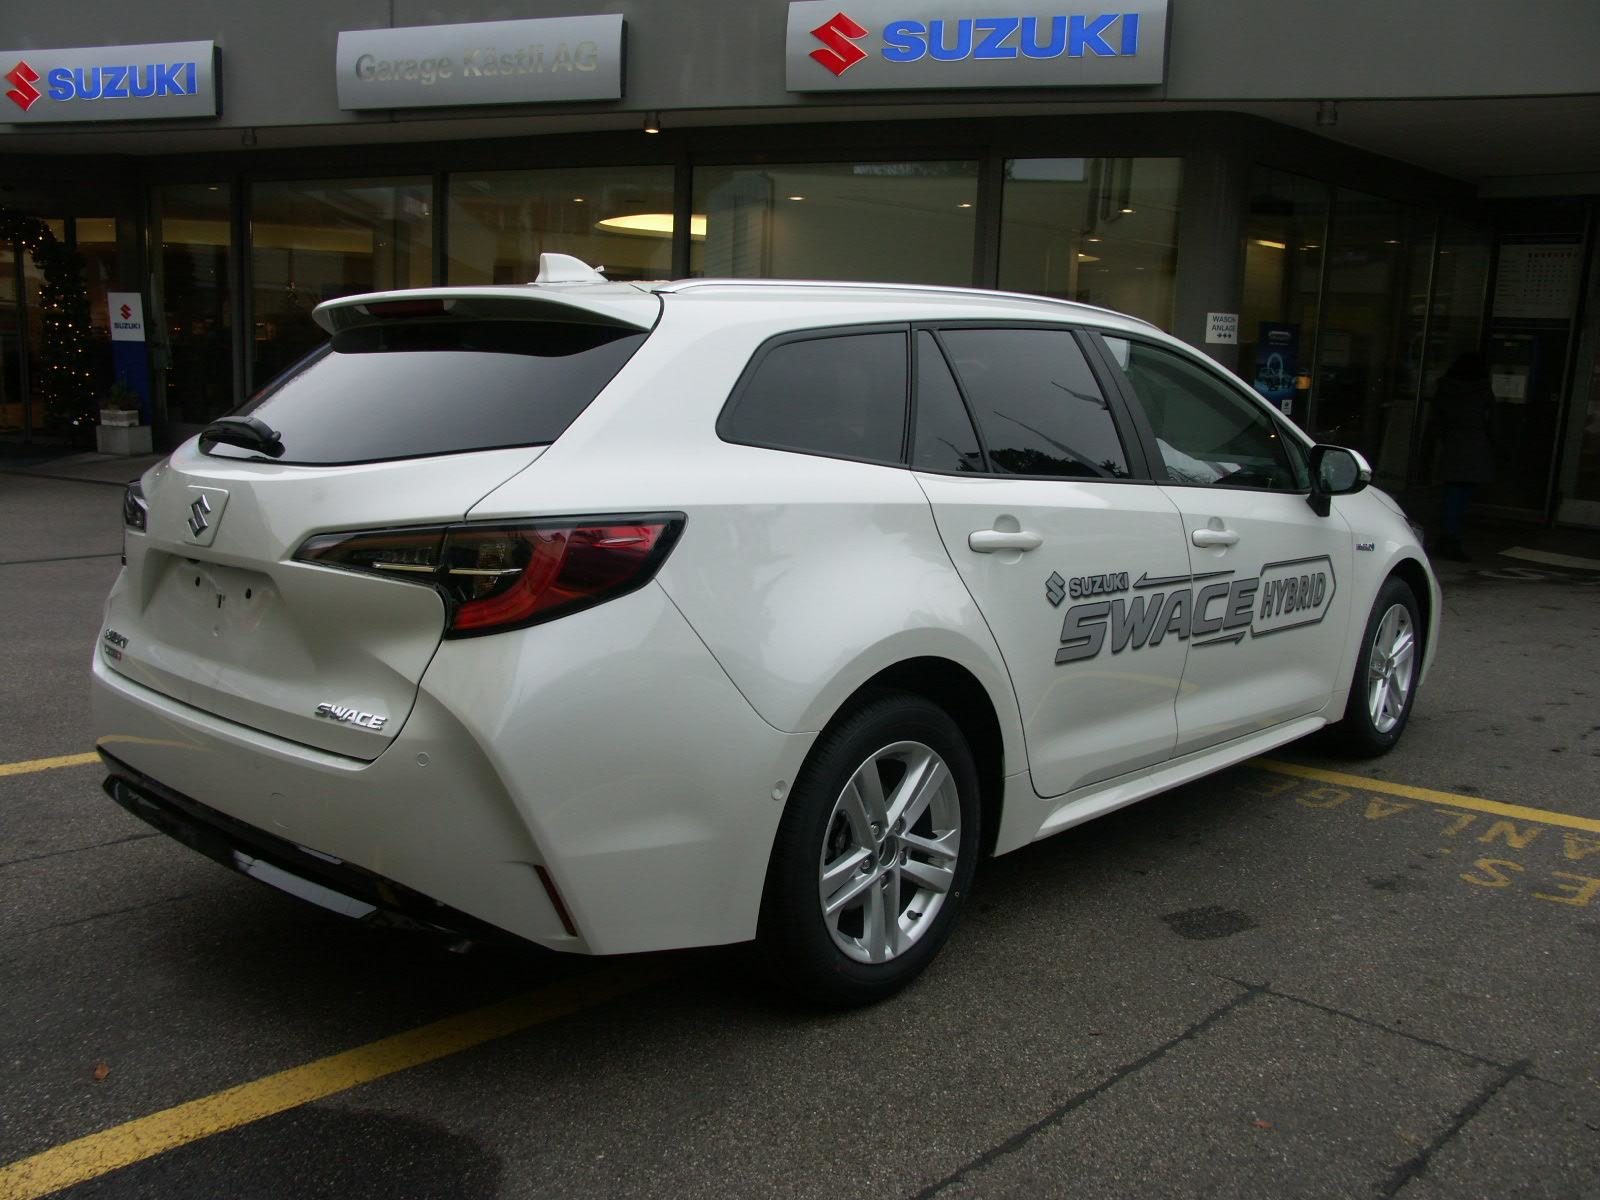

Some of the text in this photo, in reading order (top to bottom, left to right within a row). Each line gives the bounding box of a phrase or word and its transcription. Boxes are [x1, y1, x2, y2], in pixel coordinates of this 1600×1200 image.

[881, 13, 1139, 62] SUZUKI
[47, 62, 198, 101] SUZUKI
[355, 54, 452, 85] Garage
[551, 41, 599, 73] AG
[113, 322, 141, 330] SUZUKI
[1068, 571, 1129, 598] SUZUKI
[1054, 571, 1327, 666] SWACE HYBRID
[315, 702, 388, 731] SWACE
